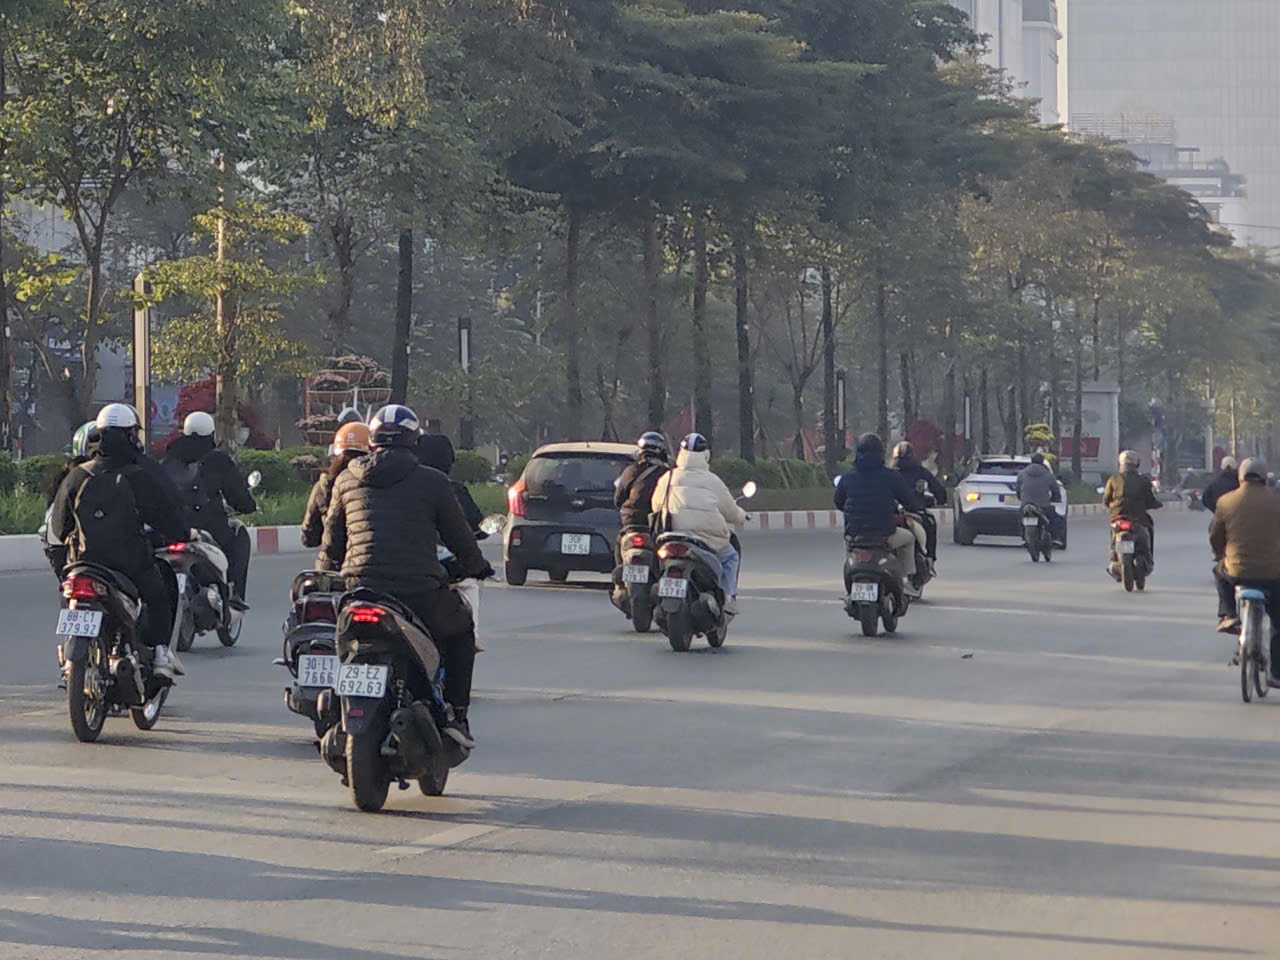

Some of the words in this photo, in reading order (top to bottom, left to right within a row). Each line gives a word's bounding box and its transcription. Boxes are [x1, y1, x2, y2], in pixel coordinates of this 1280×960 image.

[60, 622, 97, 635] 379.92
[304, 671, 334, 684] 7666
[345, 666, 380, 680] 29-E2
[340, 680, 383, 695] 692.63
